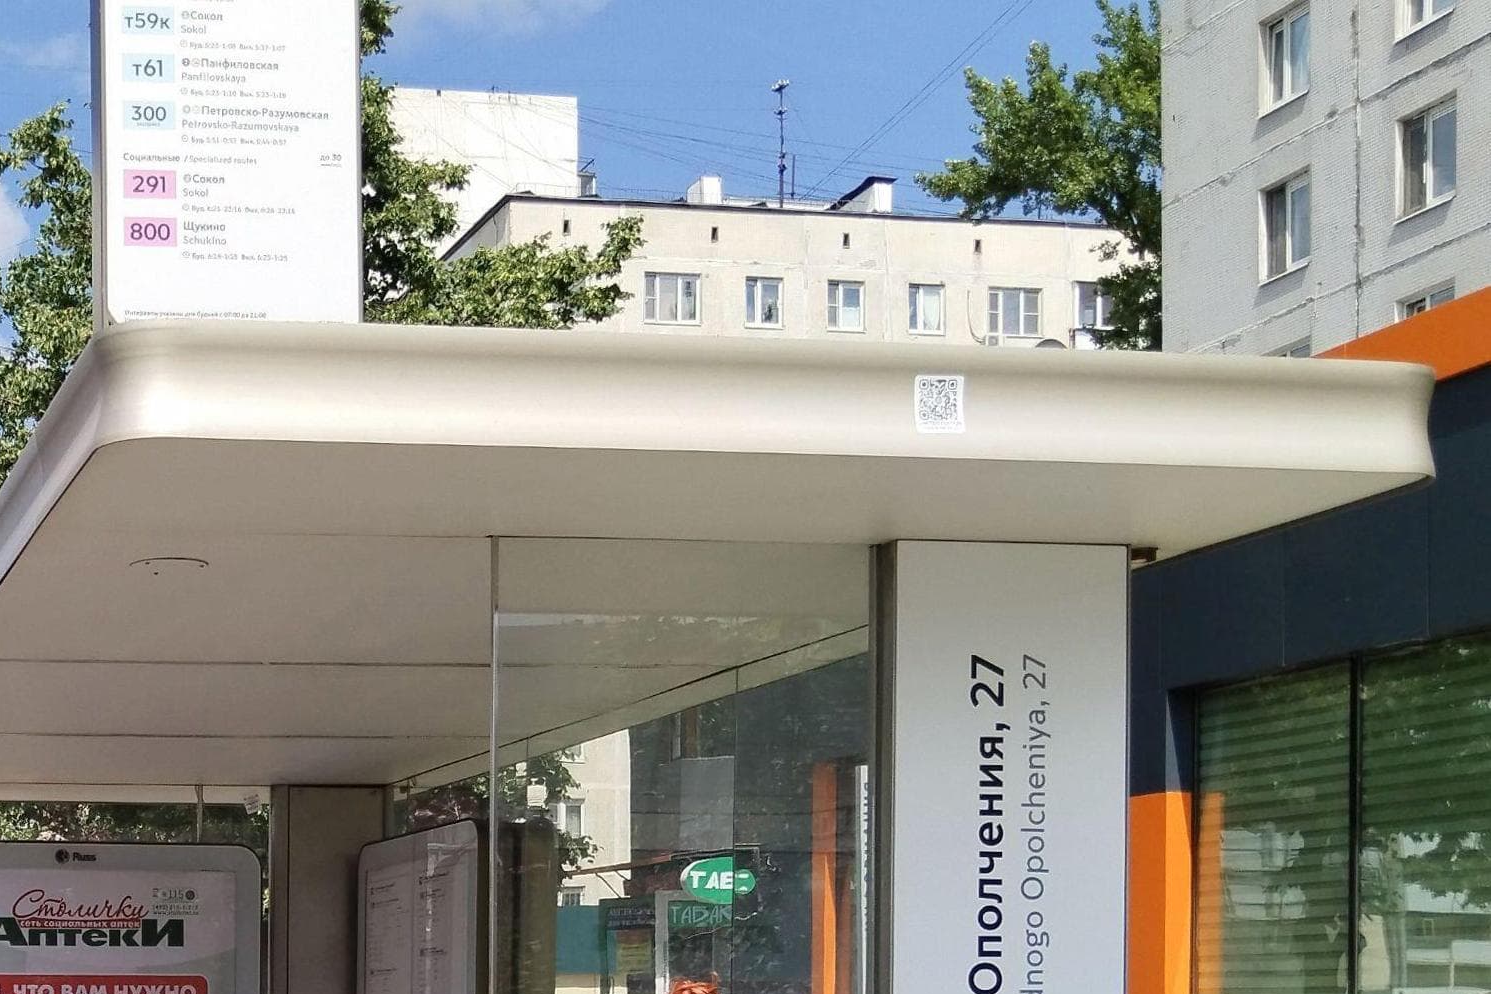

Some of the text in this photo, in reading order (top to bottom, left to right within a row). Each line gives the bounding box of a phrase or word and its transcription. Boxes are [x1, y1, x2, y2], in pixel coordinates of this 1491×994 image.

[124, 12, 170, 29] т59к
[190, 11, 223, 21] Сокол
[180, 25, 207, 34] Sokol
[132, 59, 164, 77] т61
[201, 58, 279, 71] Панфиловская
[181, 72, 247, 84] Panfilovskaya
[131, 106, 167, 121] 300
[201, 105, 329, 120] Петровско-Разумовская
[181, 120, 300, 133] Petrovsko-Razumovskaya
[132, 175, 166, 193] 291
[192, 174, 225, 184] Сокол
[182, 188, 209, 198] Sokol
[130, 223, 171, 241] 800
[183, 221, 226, 233] Щукино
[182, 234, 227, 246] Schukino
[1022, 654, 1047, 690] 27
[970, 654, 1004, 708] 27
[1020, 701, 1051, 901] Opolcheniya,
[72, 851, 97, 862] Russ
[12, 889, 149, 919] Столички
[20, 920, 141, 929] сеть социальных аптек
